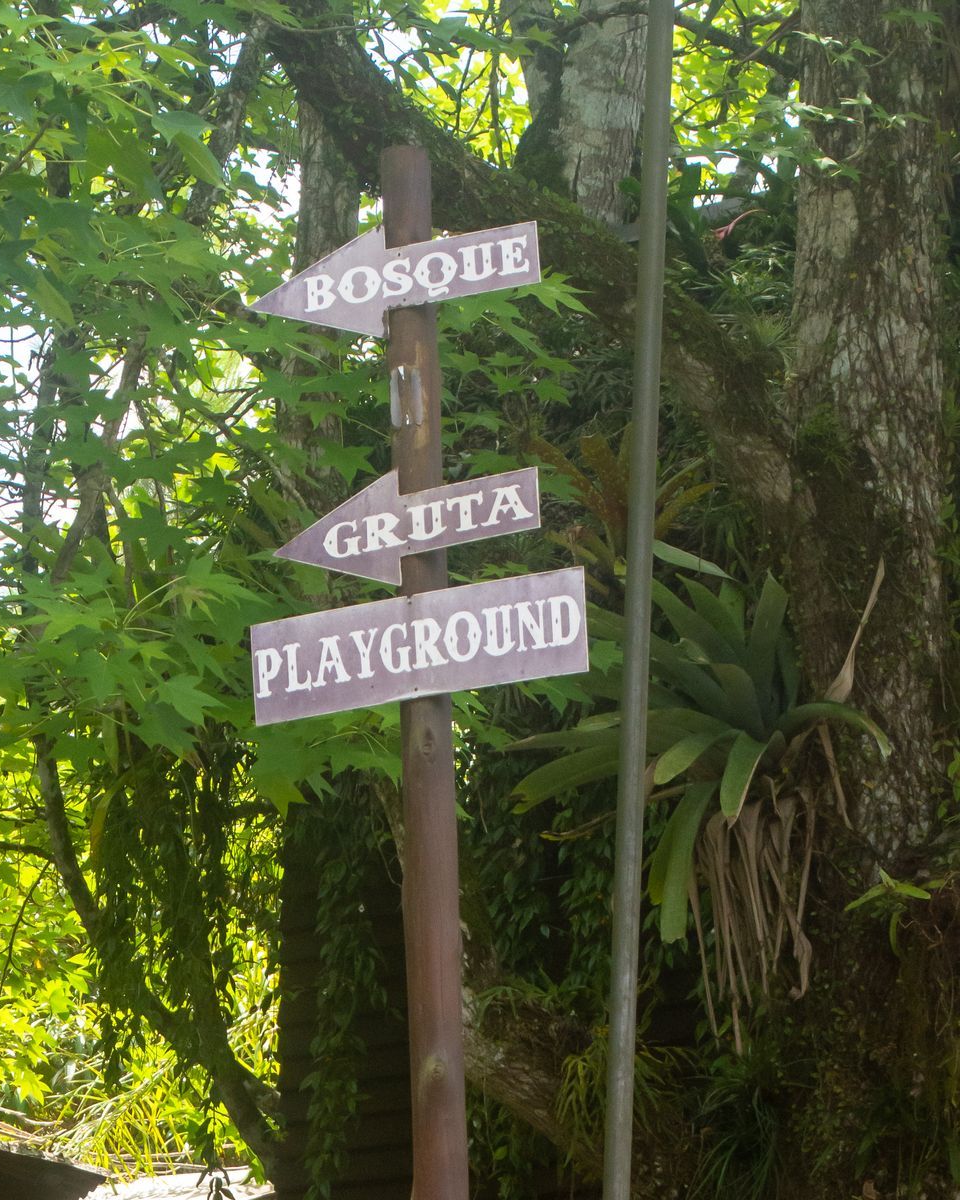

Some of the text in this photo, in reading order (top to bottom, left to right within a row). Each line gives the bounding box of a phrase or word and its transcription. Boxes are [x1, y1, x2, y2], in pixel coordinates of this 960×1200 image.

[304, 234, 531, 313] BOSQUE
[322, 484, 533, 558] GRUTA
[254, 594, 582, 699] PLAYGROUND
